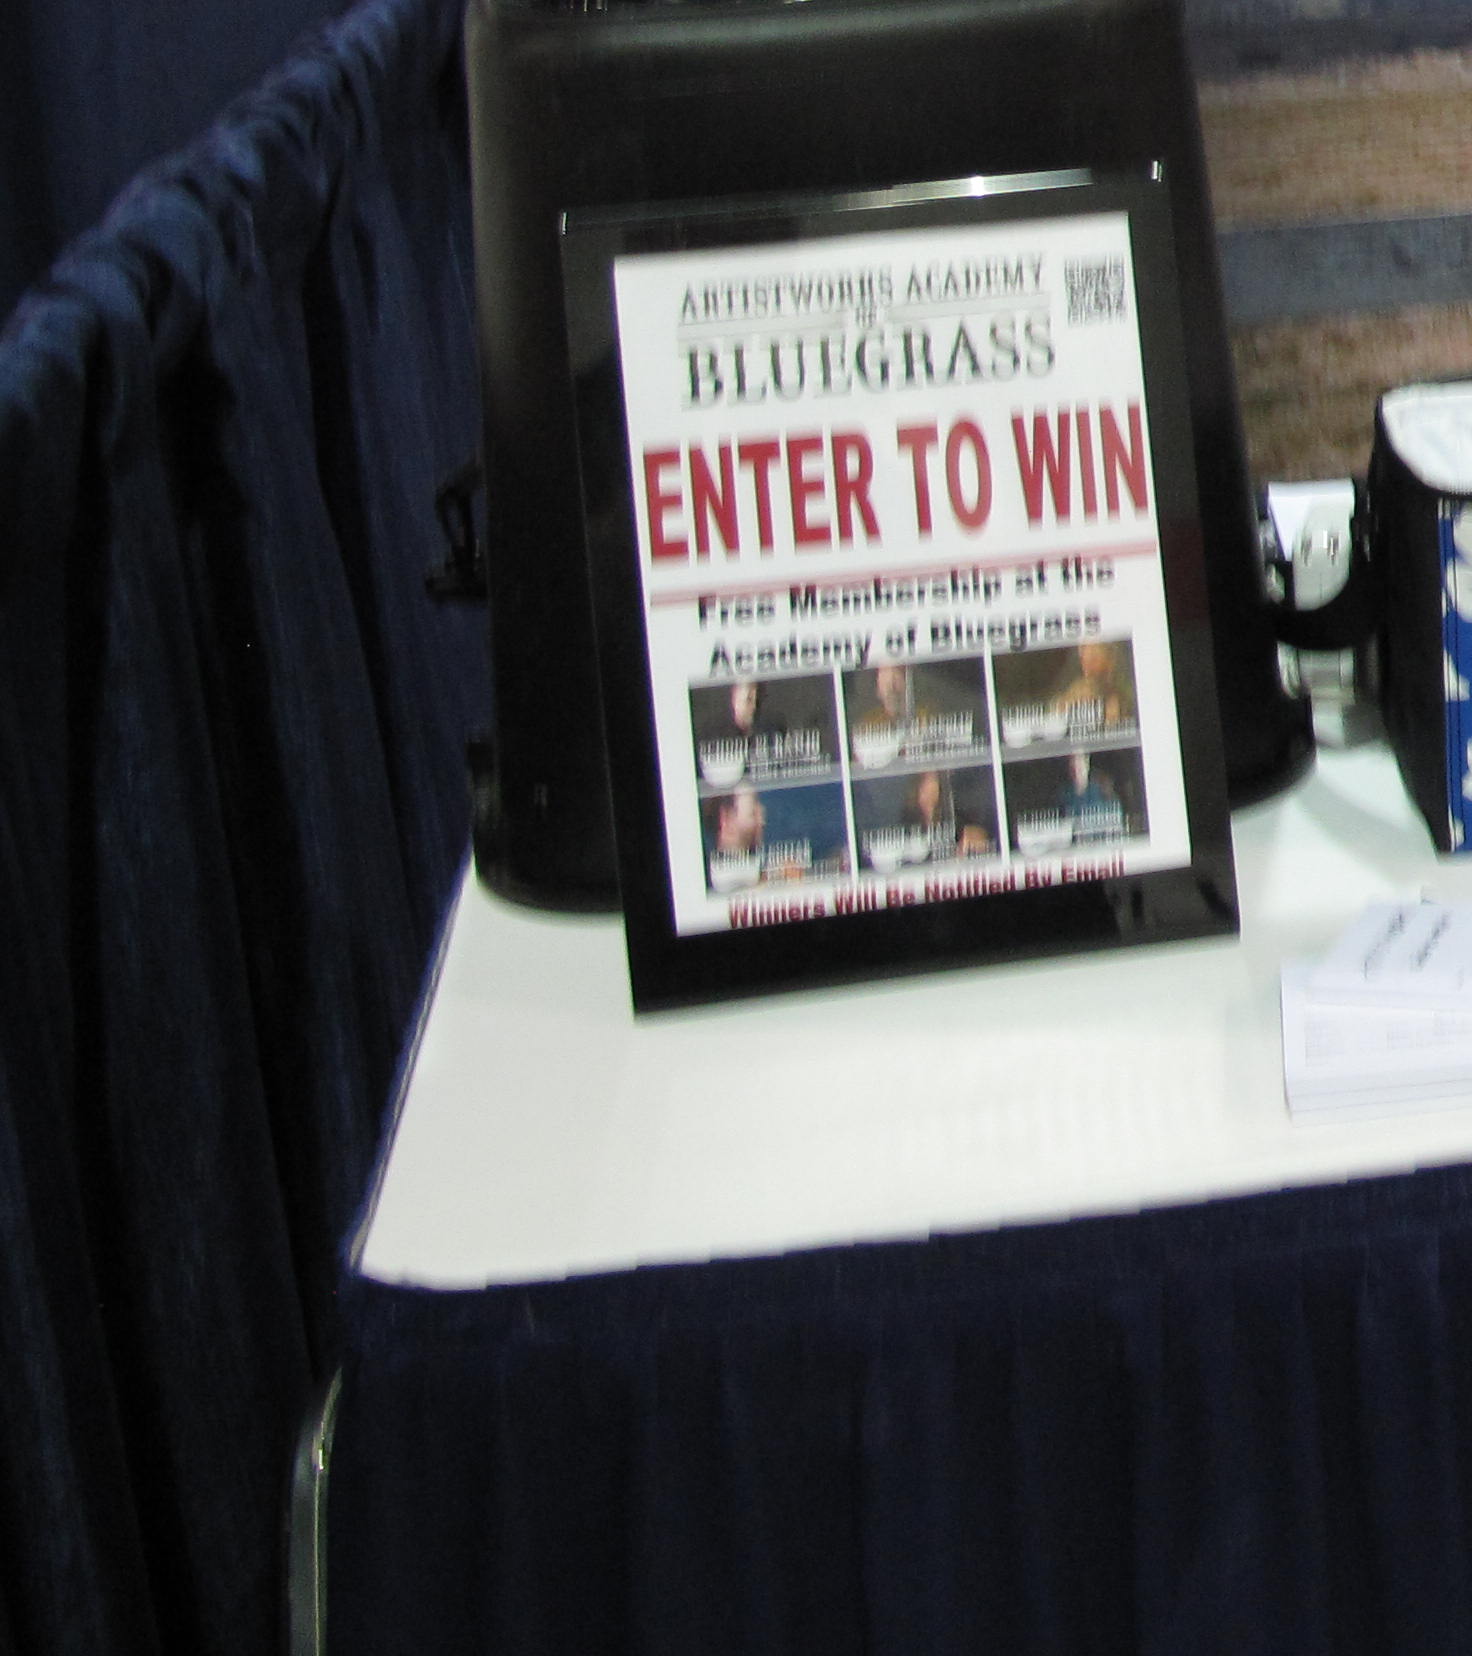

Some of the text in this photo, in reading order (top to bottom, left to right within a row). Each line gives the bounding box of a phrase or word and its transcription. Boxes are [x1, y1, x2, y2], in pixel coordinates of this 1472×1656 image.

[905, 251, 1045, 305] ACADEMY
[679, 312, 1057, 412] BLUEGRASS
[643, 399, 1150, 565] ENTER TO WIN
[698, 552, 1116, 631] Free Membership at the
[709, 605, 1101, 679] Academy of Bluegrass
[729, 847, 1126, 930] Winners Will Be Notified By Email
